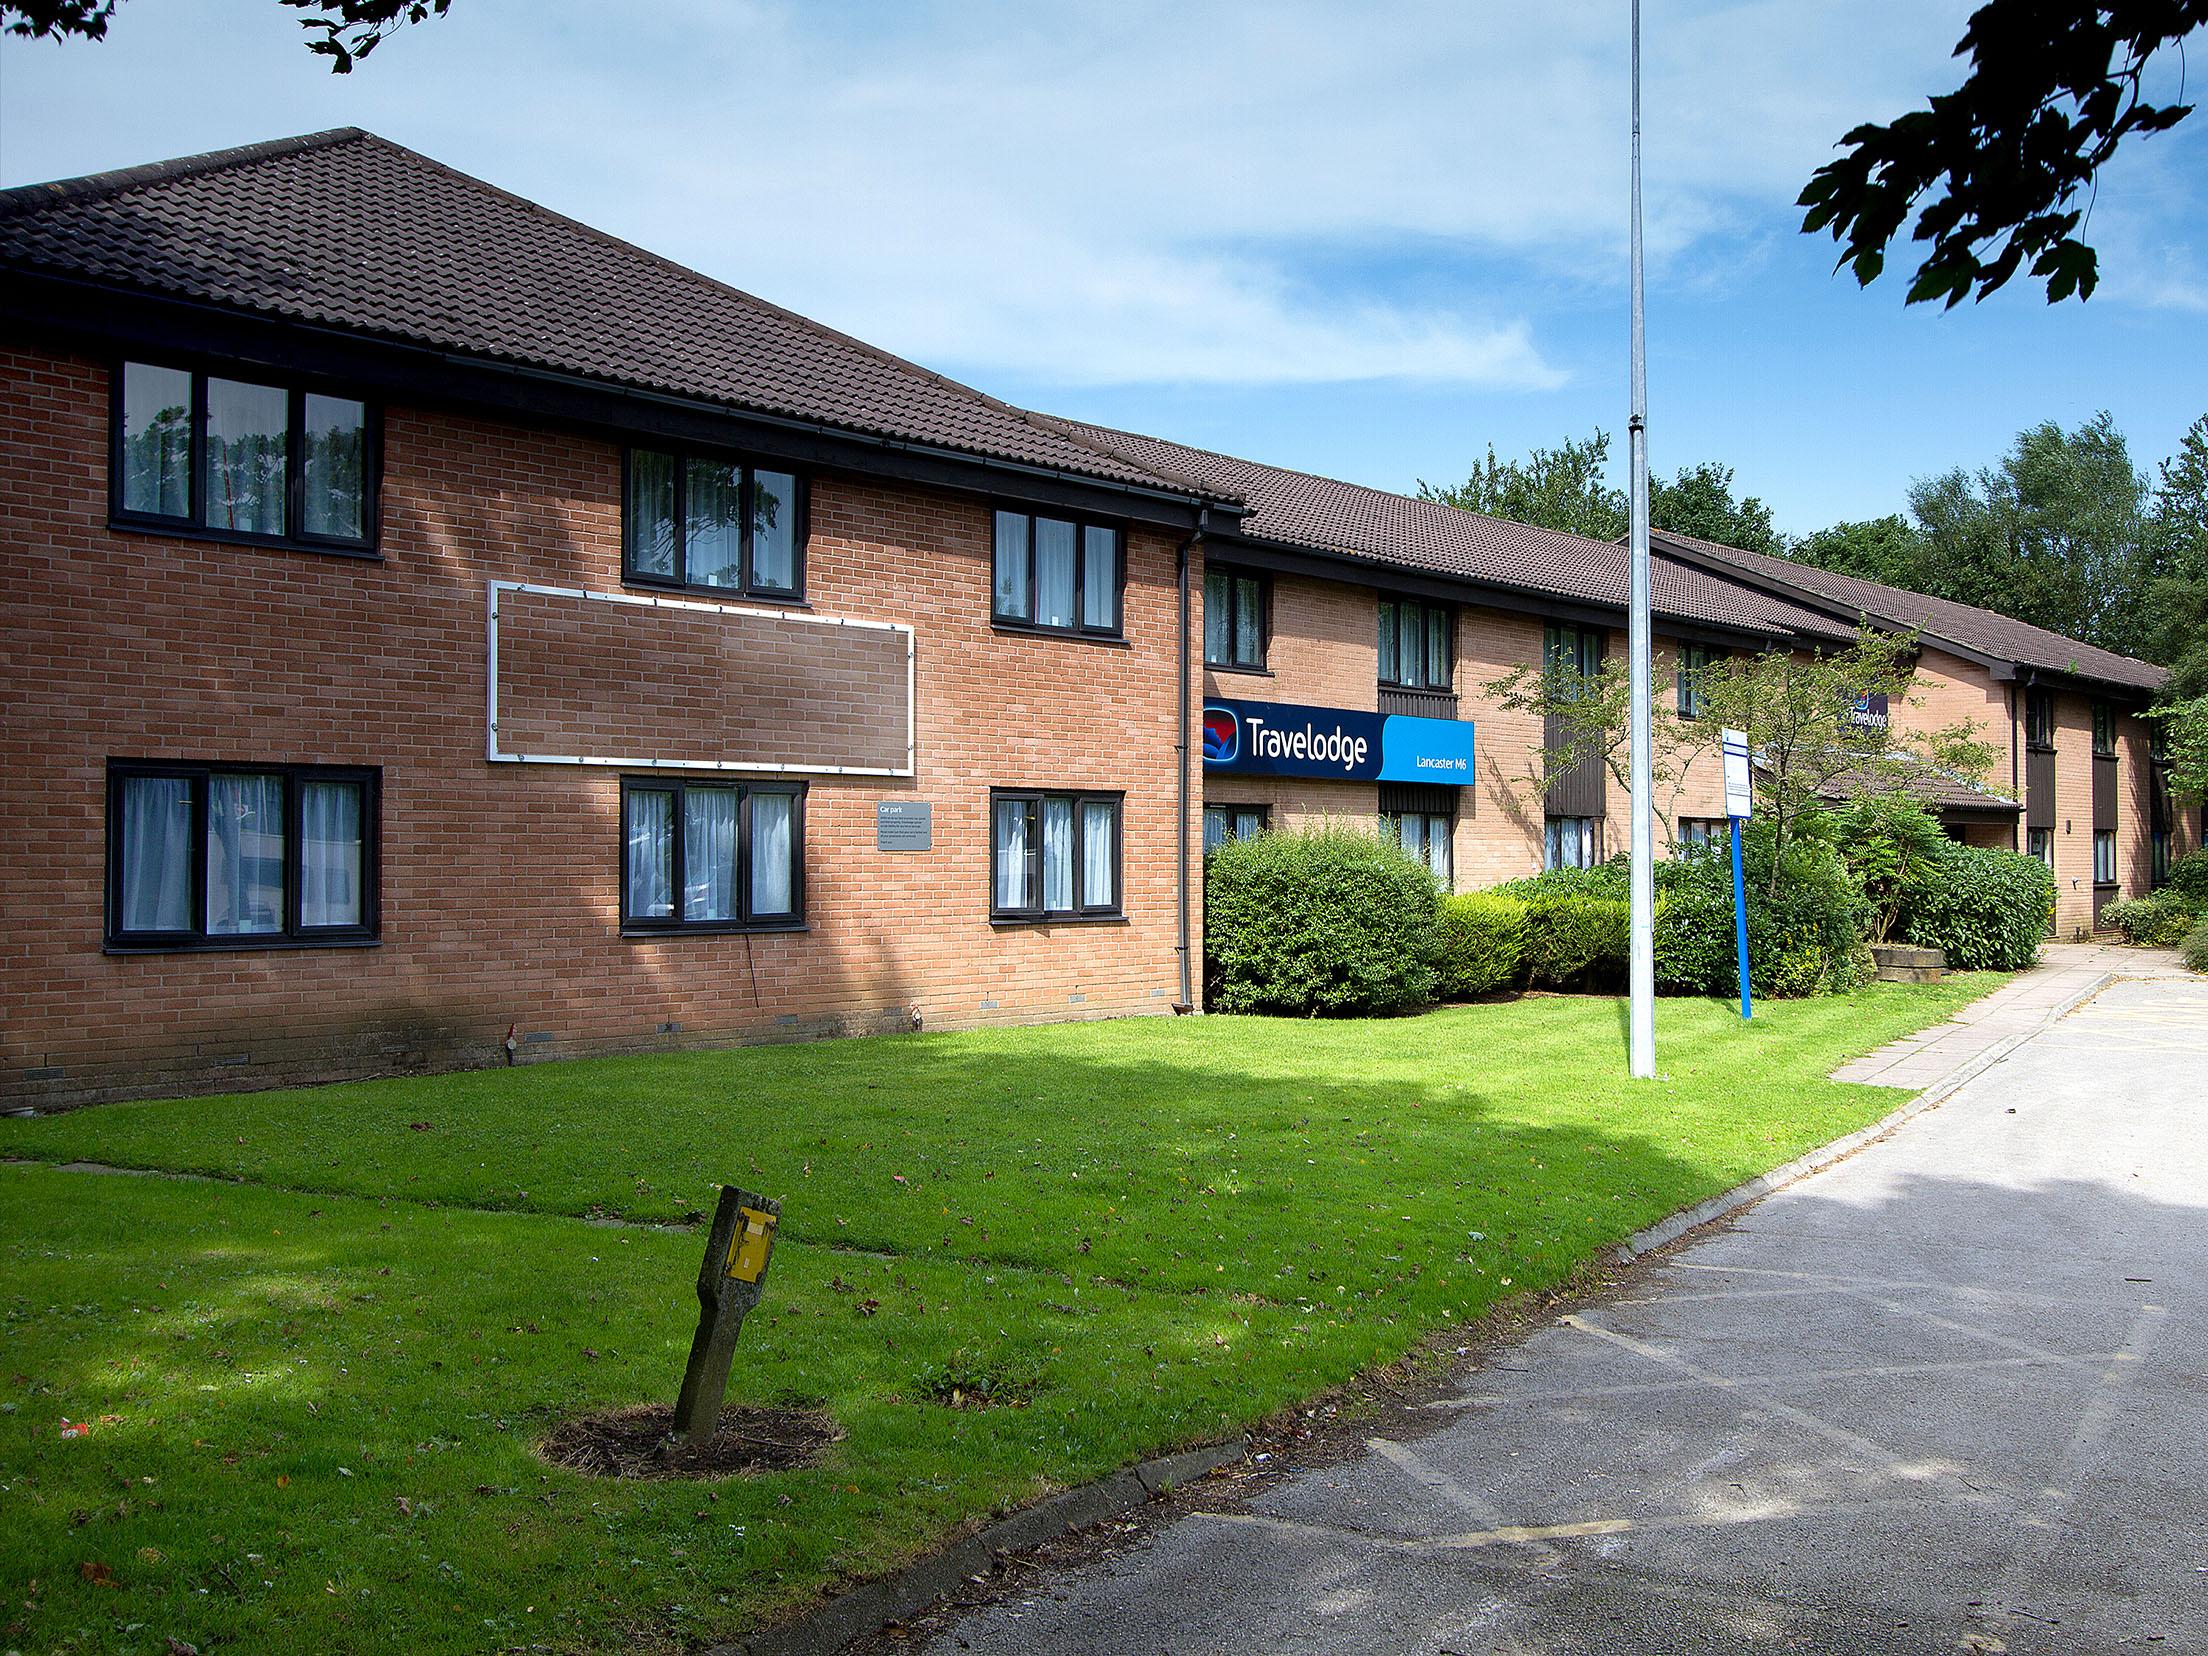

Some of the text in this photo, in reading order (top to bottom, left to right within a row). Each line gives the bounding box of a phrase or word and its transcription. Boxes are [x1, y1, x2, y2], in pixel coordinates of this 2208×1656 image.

[1849, 706, 1887, 731] Travelodge
[1245, 717, 1368, 771] Travelodge
[1416, 755, 1467, 771] Lancaster M6
[890, 806, 903, 814] park
